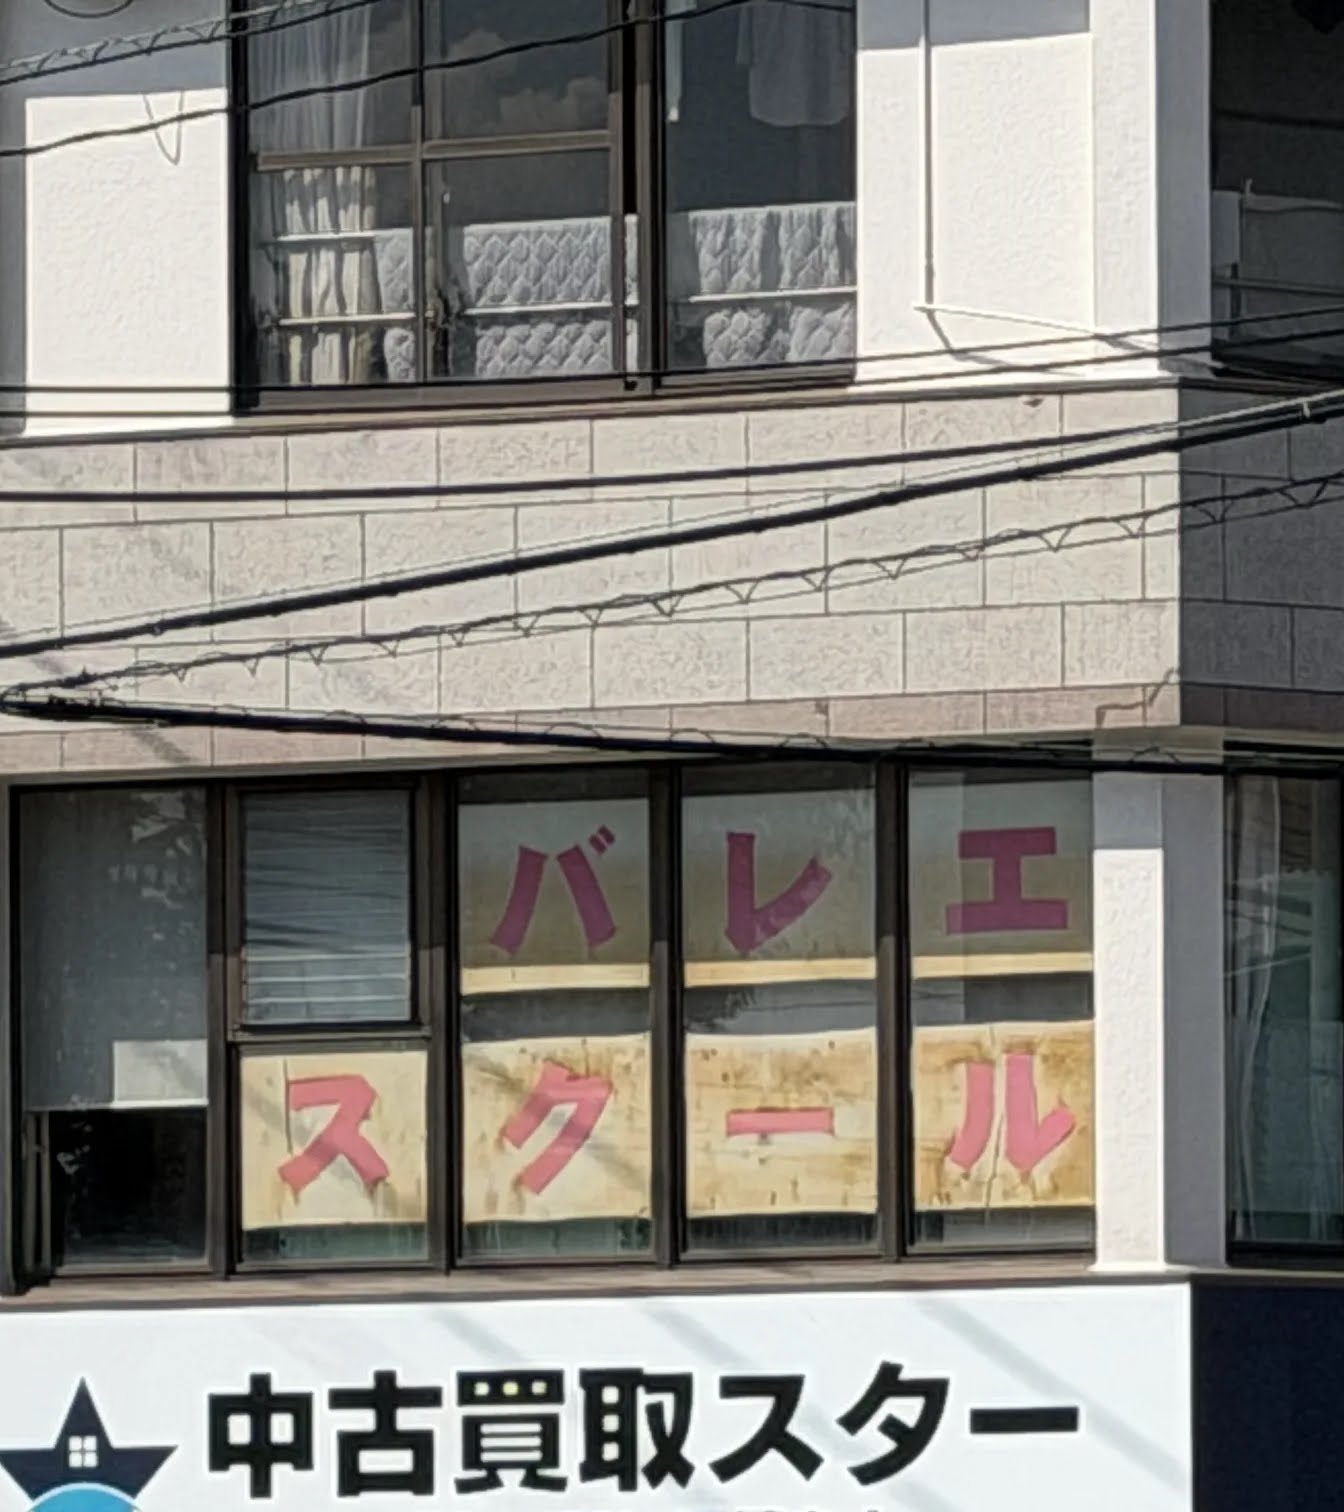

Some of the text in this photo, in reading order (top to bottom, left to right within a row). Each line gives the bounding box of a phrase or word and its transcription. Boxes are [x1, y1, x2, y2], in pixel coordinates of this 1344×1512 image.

[491, 824, 1069, 956] バレエ
[279, 1050, 1076, 1195] スクール
[206, 1361, 1082, 1500] 中古買取スター
